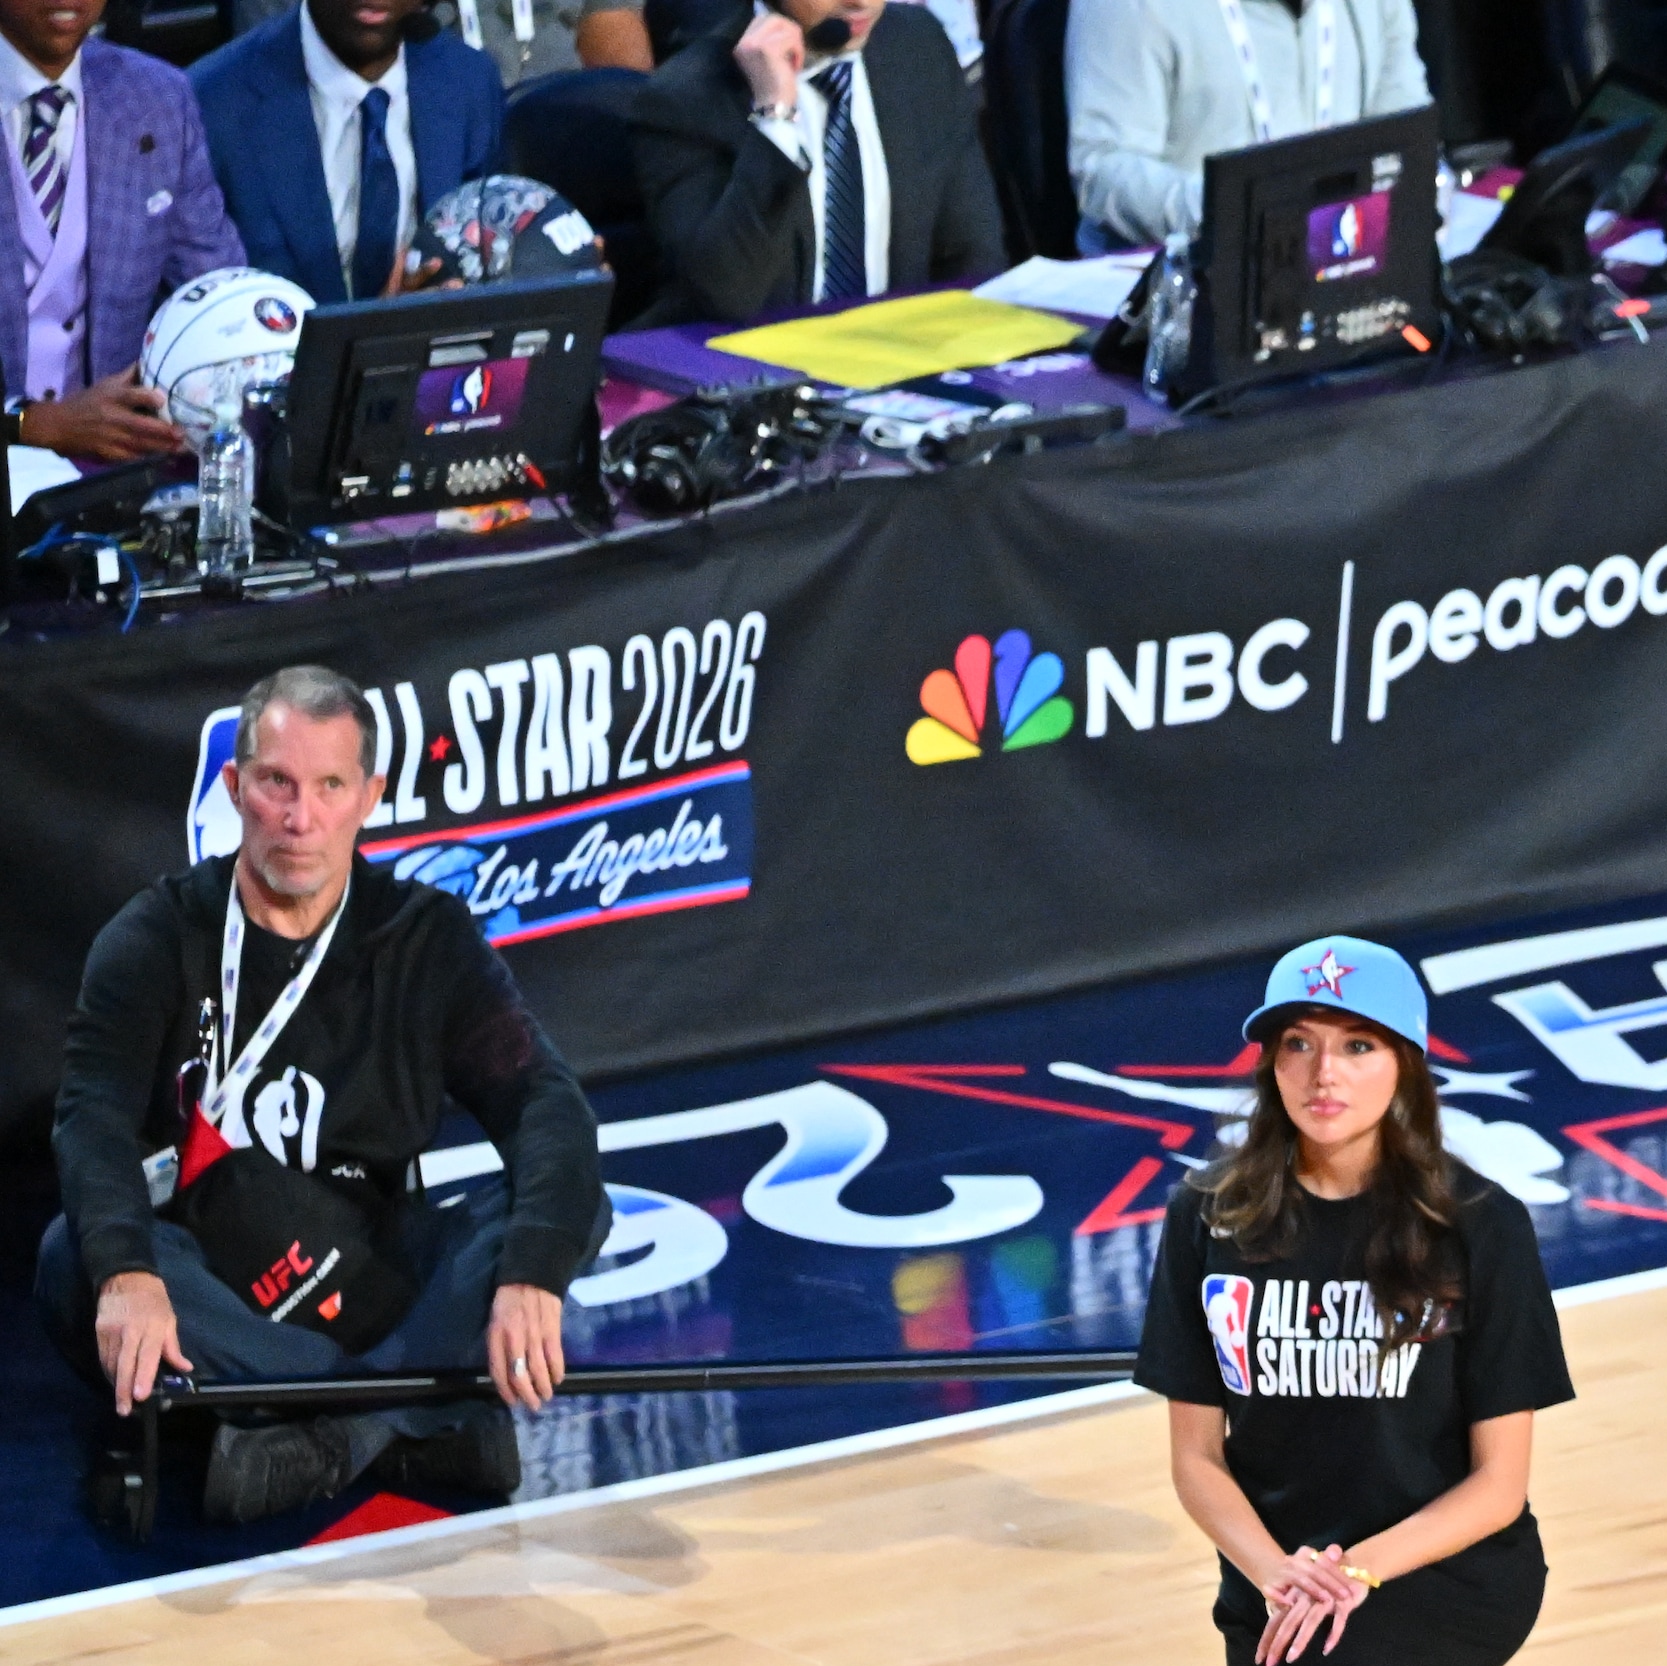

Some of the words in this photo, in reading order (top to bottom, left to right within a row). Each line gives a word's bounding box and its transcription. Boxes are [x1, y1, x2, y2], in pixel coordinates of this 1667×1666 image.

[360, 682, 427, 828] LL
[619, 610, 767, 780] 2026
[1085, 618, 1310, 738] NBC
[466, 844, 540, 916] Los
[546, 799, 728, 908] Angeles
[251, 1240, 313, 1308] UFC
[1318, 1281, 1385, 1340] STA
[1256, 1338, 1422, 1399] SATURDAY
